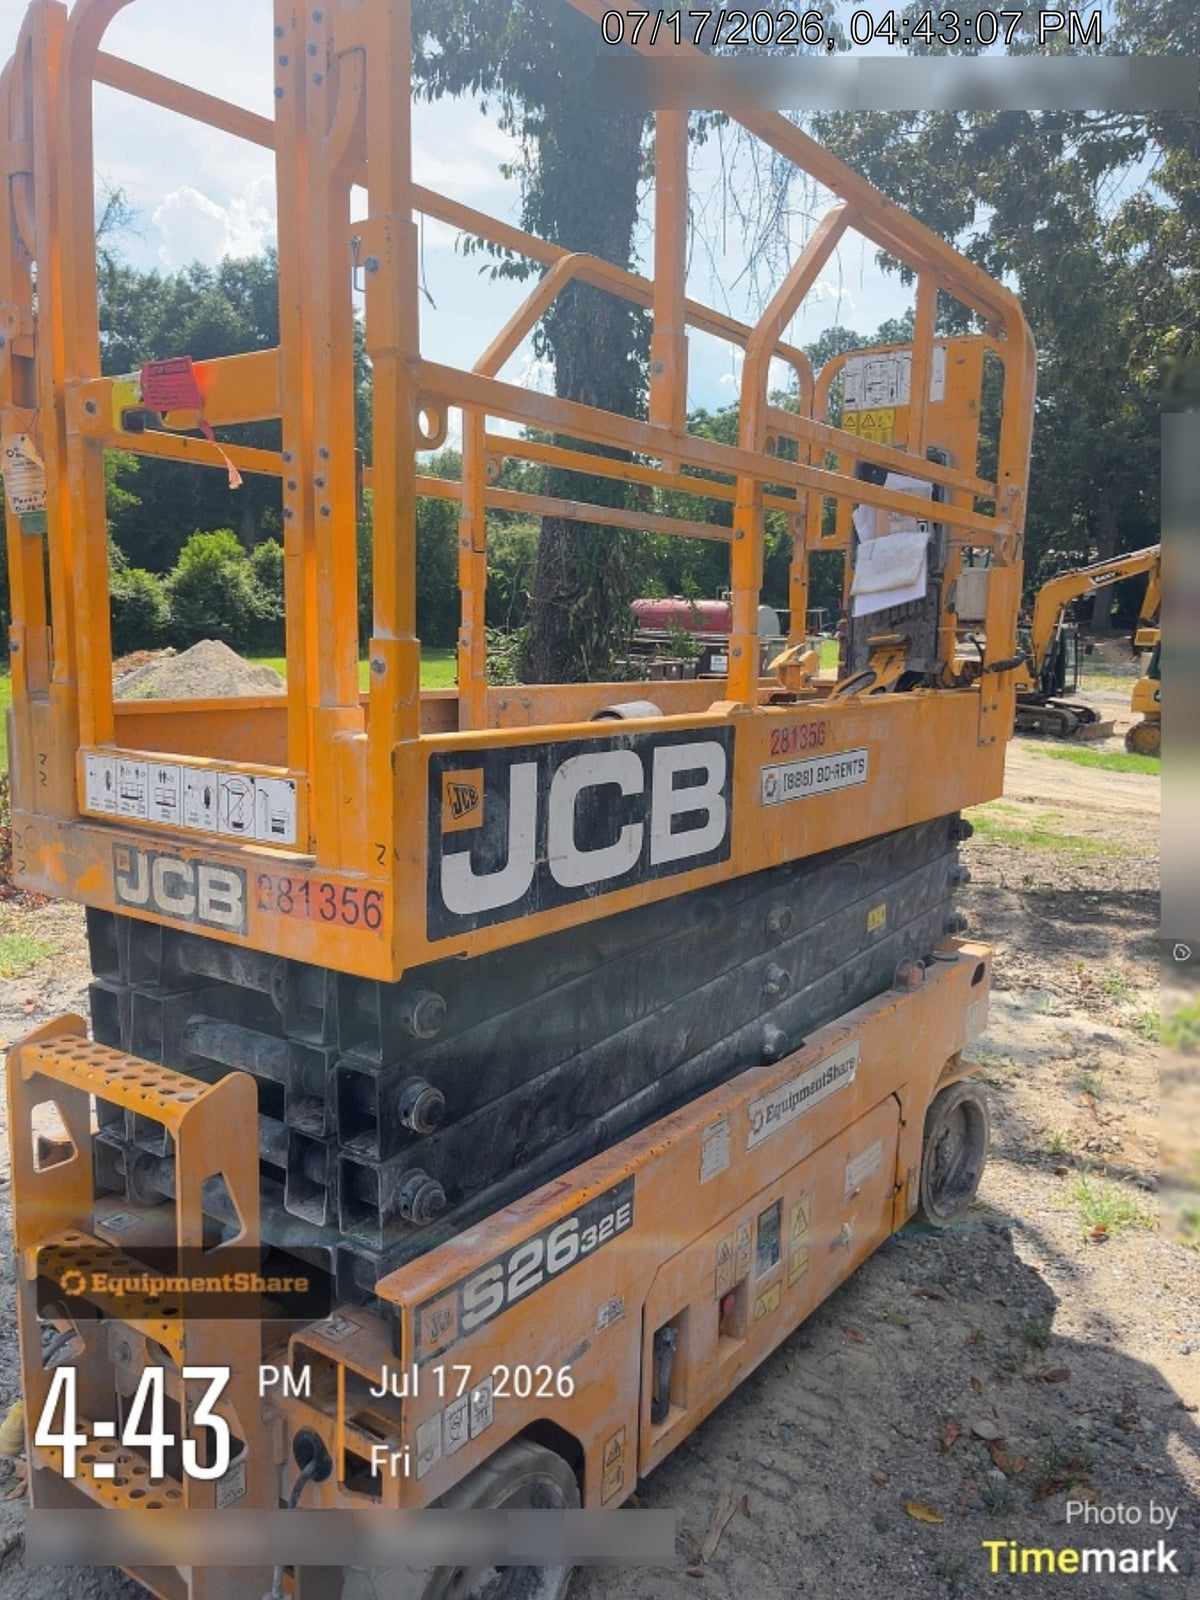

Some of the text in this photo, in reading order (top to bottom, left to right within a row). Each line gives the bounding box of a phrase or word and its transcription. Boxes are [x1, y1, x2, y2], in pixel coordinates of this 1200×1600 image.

[770, 721, 826, 756] 281356
[440, 741, 727, 915] JCB
[452, 783, 478, 815] JCB
[117, 852, 244, 927] JCB
[255, 873, 383, 929] 281356
[765, 1056, 856, 1125] EquipmentShare
